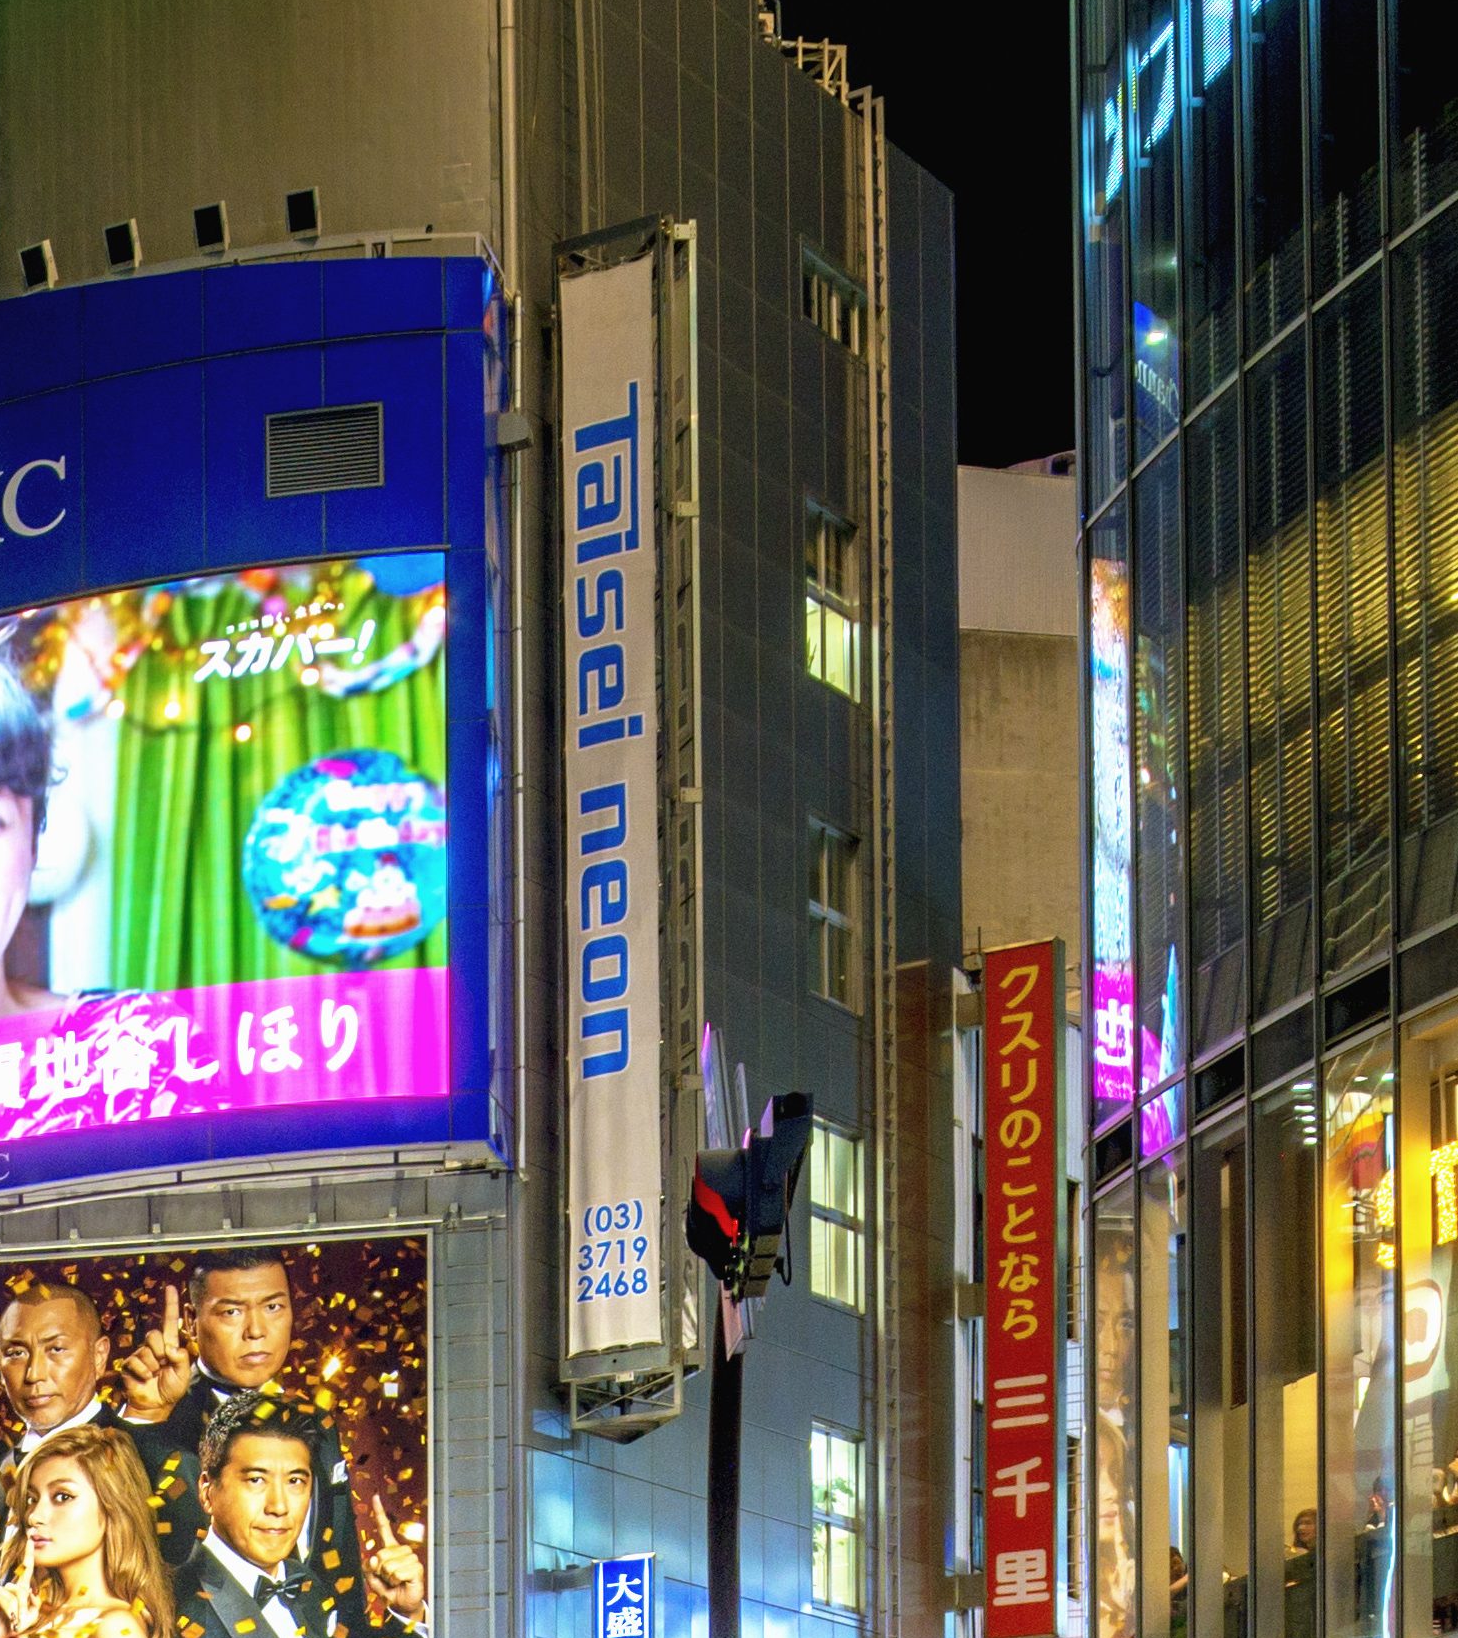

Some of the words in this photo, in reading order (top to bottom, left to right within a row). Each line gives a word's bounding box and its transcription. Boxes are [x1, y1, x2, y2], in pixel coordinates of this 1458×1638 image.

[193, 618, 376, 684] スカパー!
[578, 783, 629, 1080] neon
[997, 962, 1043, 1341] クスリのことなら
[582, 1198, 644, 1236] (03)
[576, 1237, 649, 1272] 3719
[576, 1268, 649, 1302] 2468
[992, 1372, 1051, 1610] 三千里
